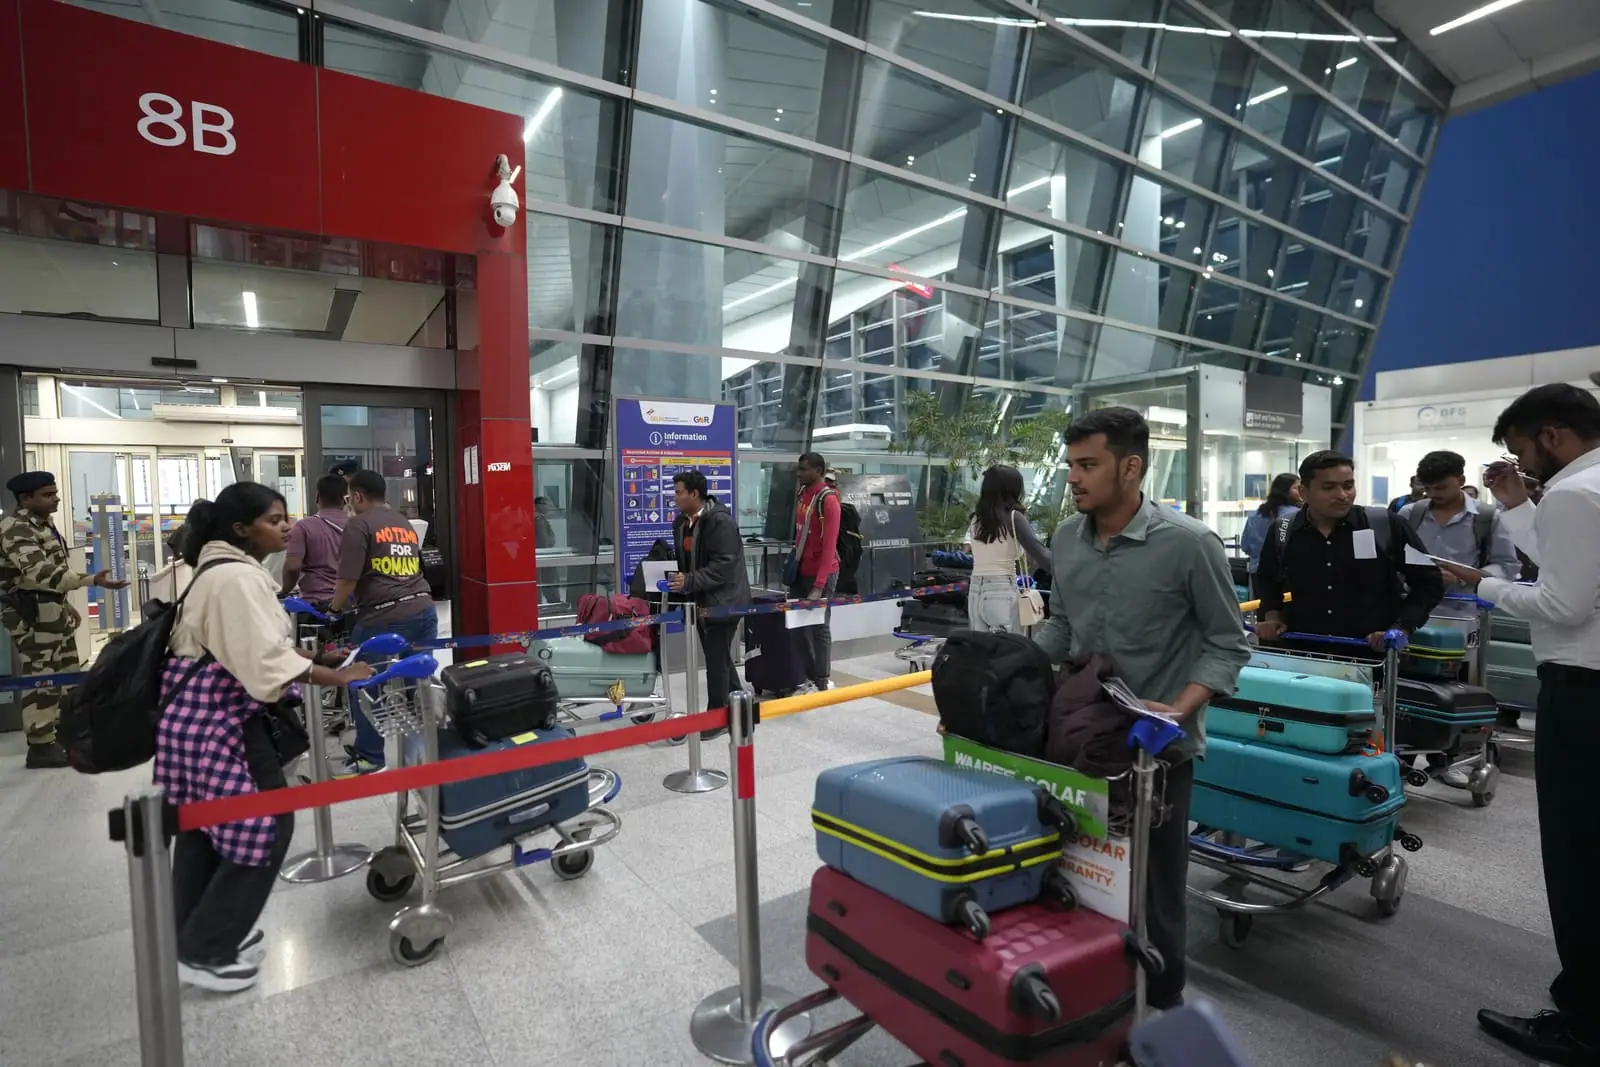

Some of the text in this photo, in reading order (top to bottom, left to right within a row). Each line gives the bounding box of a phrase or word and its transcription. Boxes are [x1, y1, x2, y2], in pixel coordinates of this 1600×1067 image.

[137, 92, 237, 156] 8B
[664, 432, 707, 440] Information
[391, 527, 418, 544] TIM
[1279, 517, 1290, 543] safari
[390, 544, 413, 556] FOR
[371, 556, 420, 576] ROMAN
